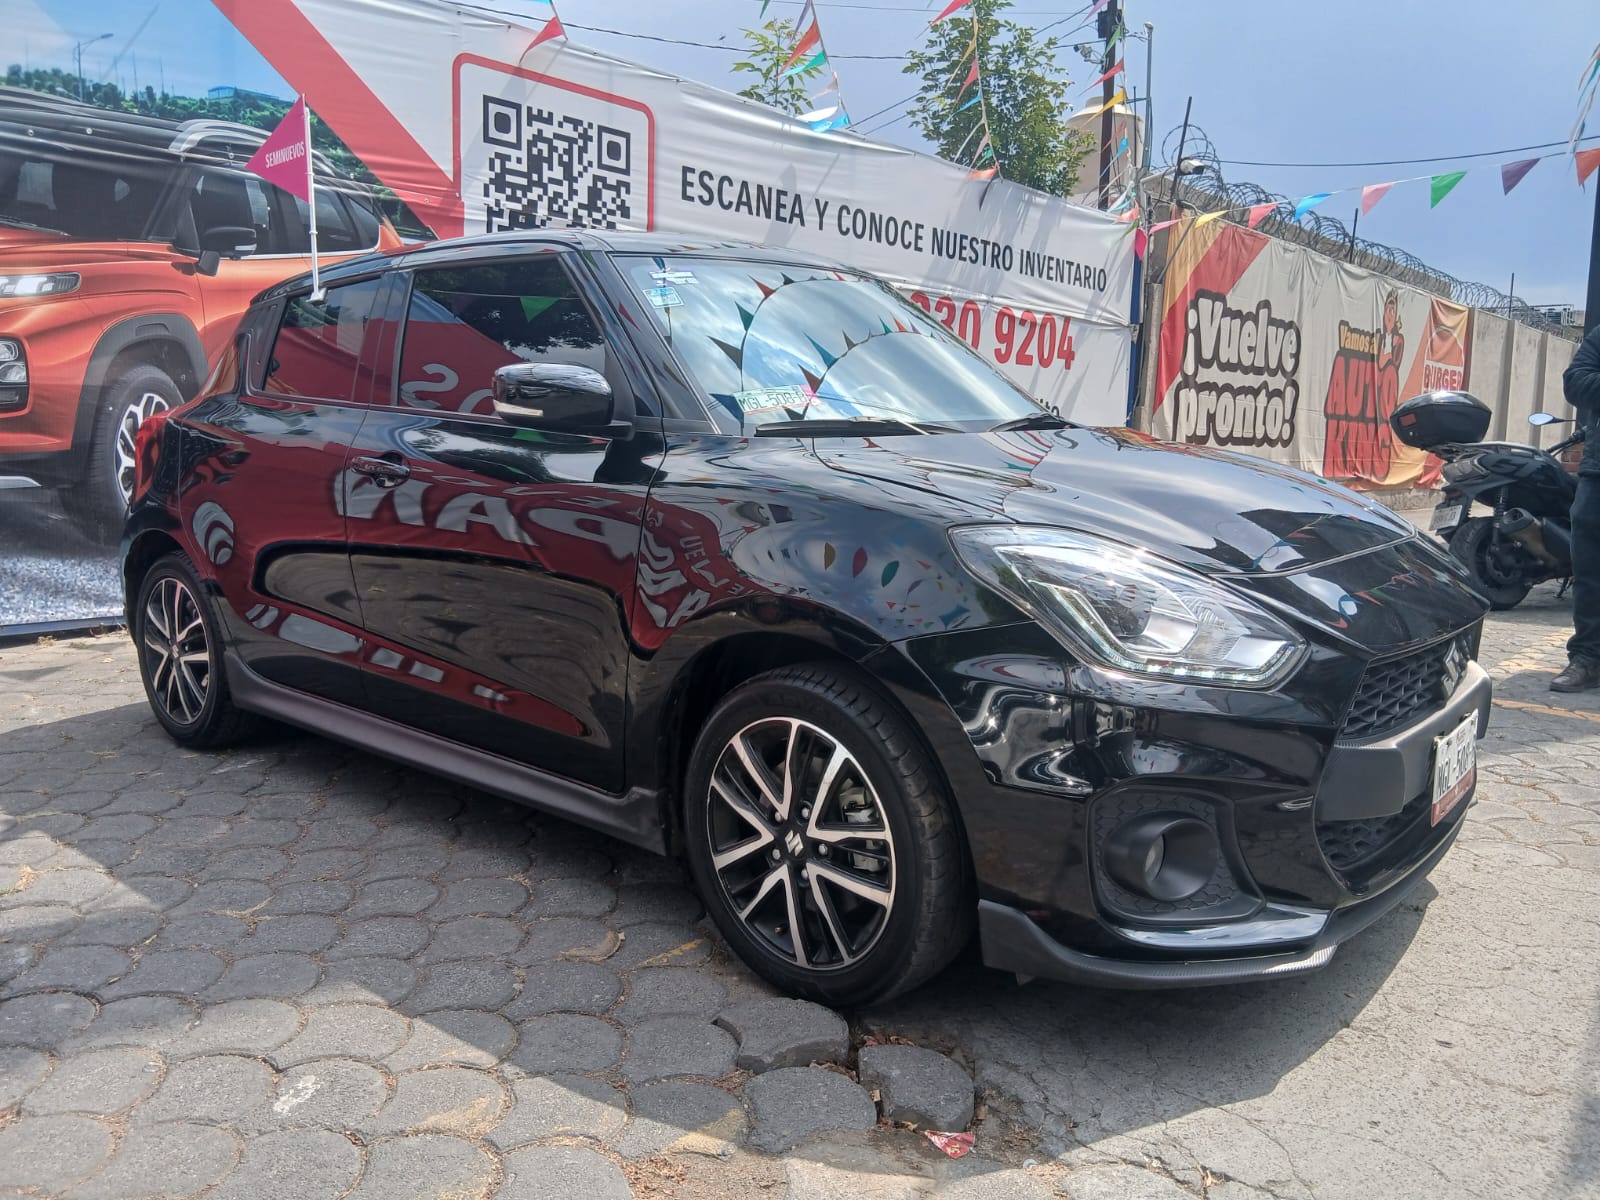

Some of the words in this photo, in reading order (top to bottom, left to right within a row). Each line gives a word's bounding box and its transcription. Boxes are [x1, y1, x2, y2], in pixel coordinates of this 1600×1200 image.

[265, 141, 304, 168] SEMINUEVOS
[681, 165, 805, 227] ESCANEA
[814, 198, 829, 231] Y
[837, 204, 925, 252] CONOCE
[931, 227, 1013, 271] NUESTRO
[1019, 249, 1107, 292] INVENTARIO
[994, 306, 1075, 371] 9204
[1183, 296, 1298, 376] ¡Vuelve
[1339, 323, 1370, 352] Vamos
[1326, 354, 1398, 421] AUTO
[1424, 364, 1463, 391] BURGER
[1175, 385, 1296, 443] pronto!
[1323, 419, 1392, 481] KING
